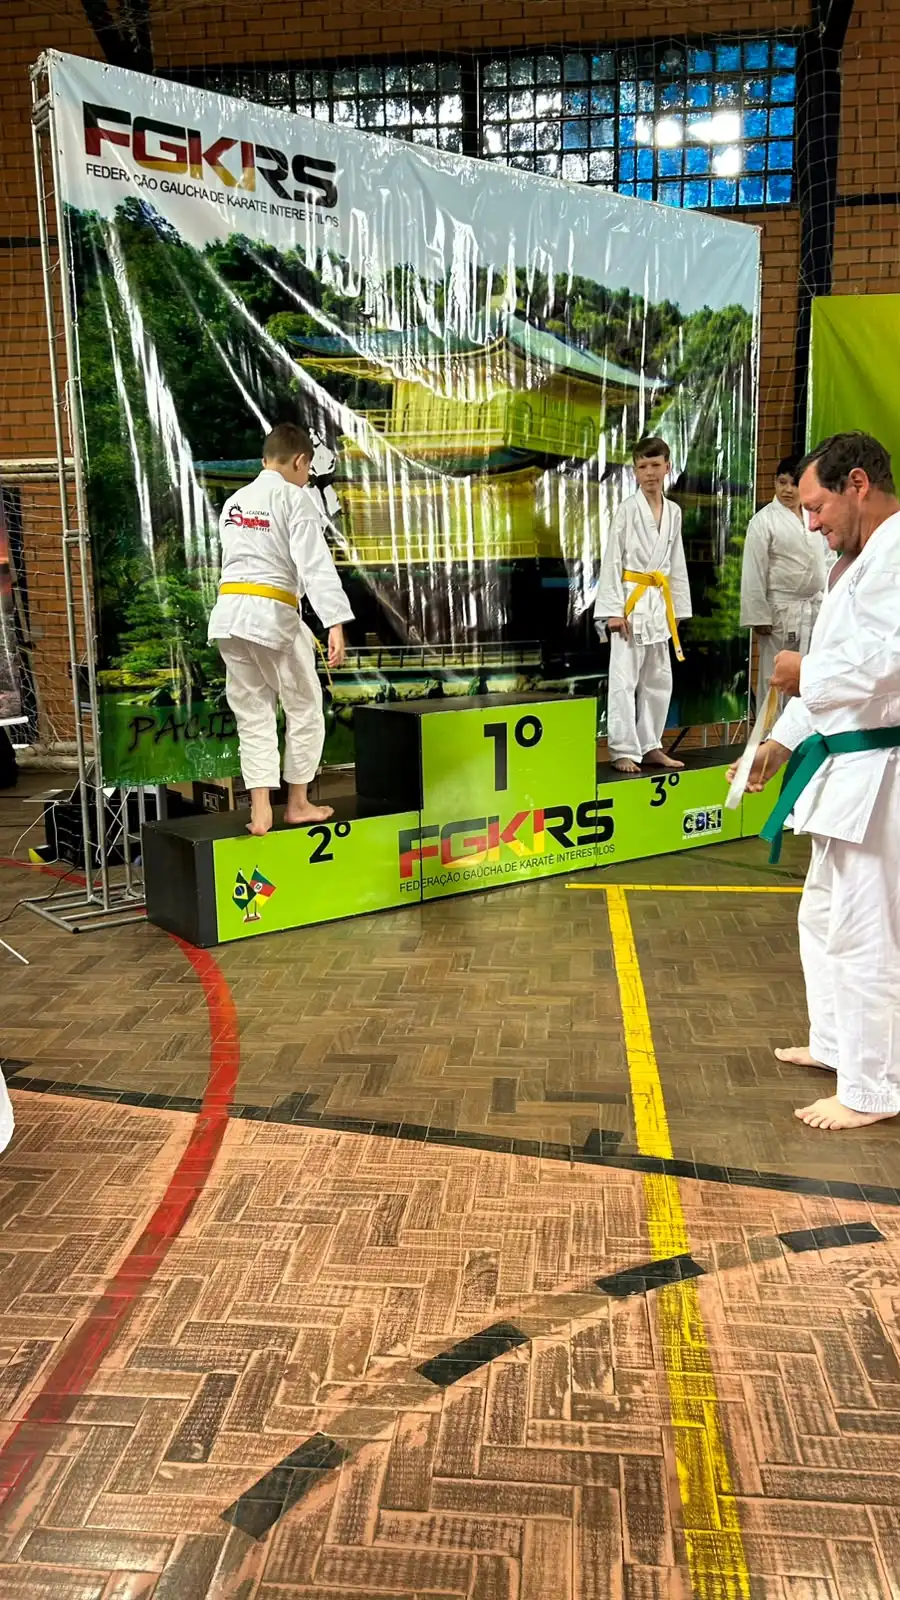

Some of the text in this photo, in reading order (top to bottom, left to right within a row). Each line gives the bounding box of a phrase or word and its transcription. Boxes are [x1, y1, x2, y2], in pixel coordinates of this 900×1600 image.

[83, 100, 338, 209] FGKIRS
[160, 180, 210, 201] GAUCHA
[210, 190, 225, 204] DE
[227, 193, 268, 214] KARATE
[484, 714, 543, 792] 1º
[650, 772, 680, 807] 3º
[307, 821, 351, 864] 2º
[398, 798, 614, 878] FGKIRS
[399, 871, 461, 893] FEDERAÇÃO
[504, 861, 518, 873] DE
[556, 843, 616, 863] INTERESTILOS
